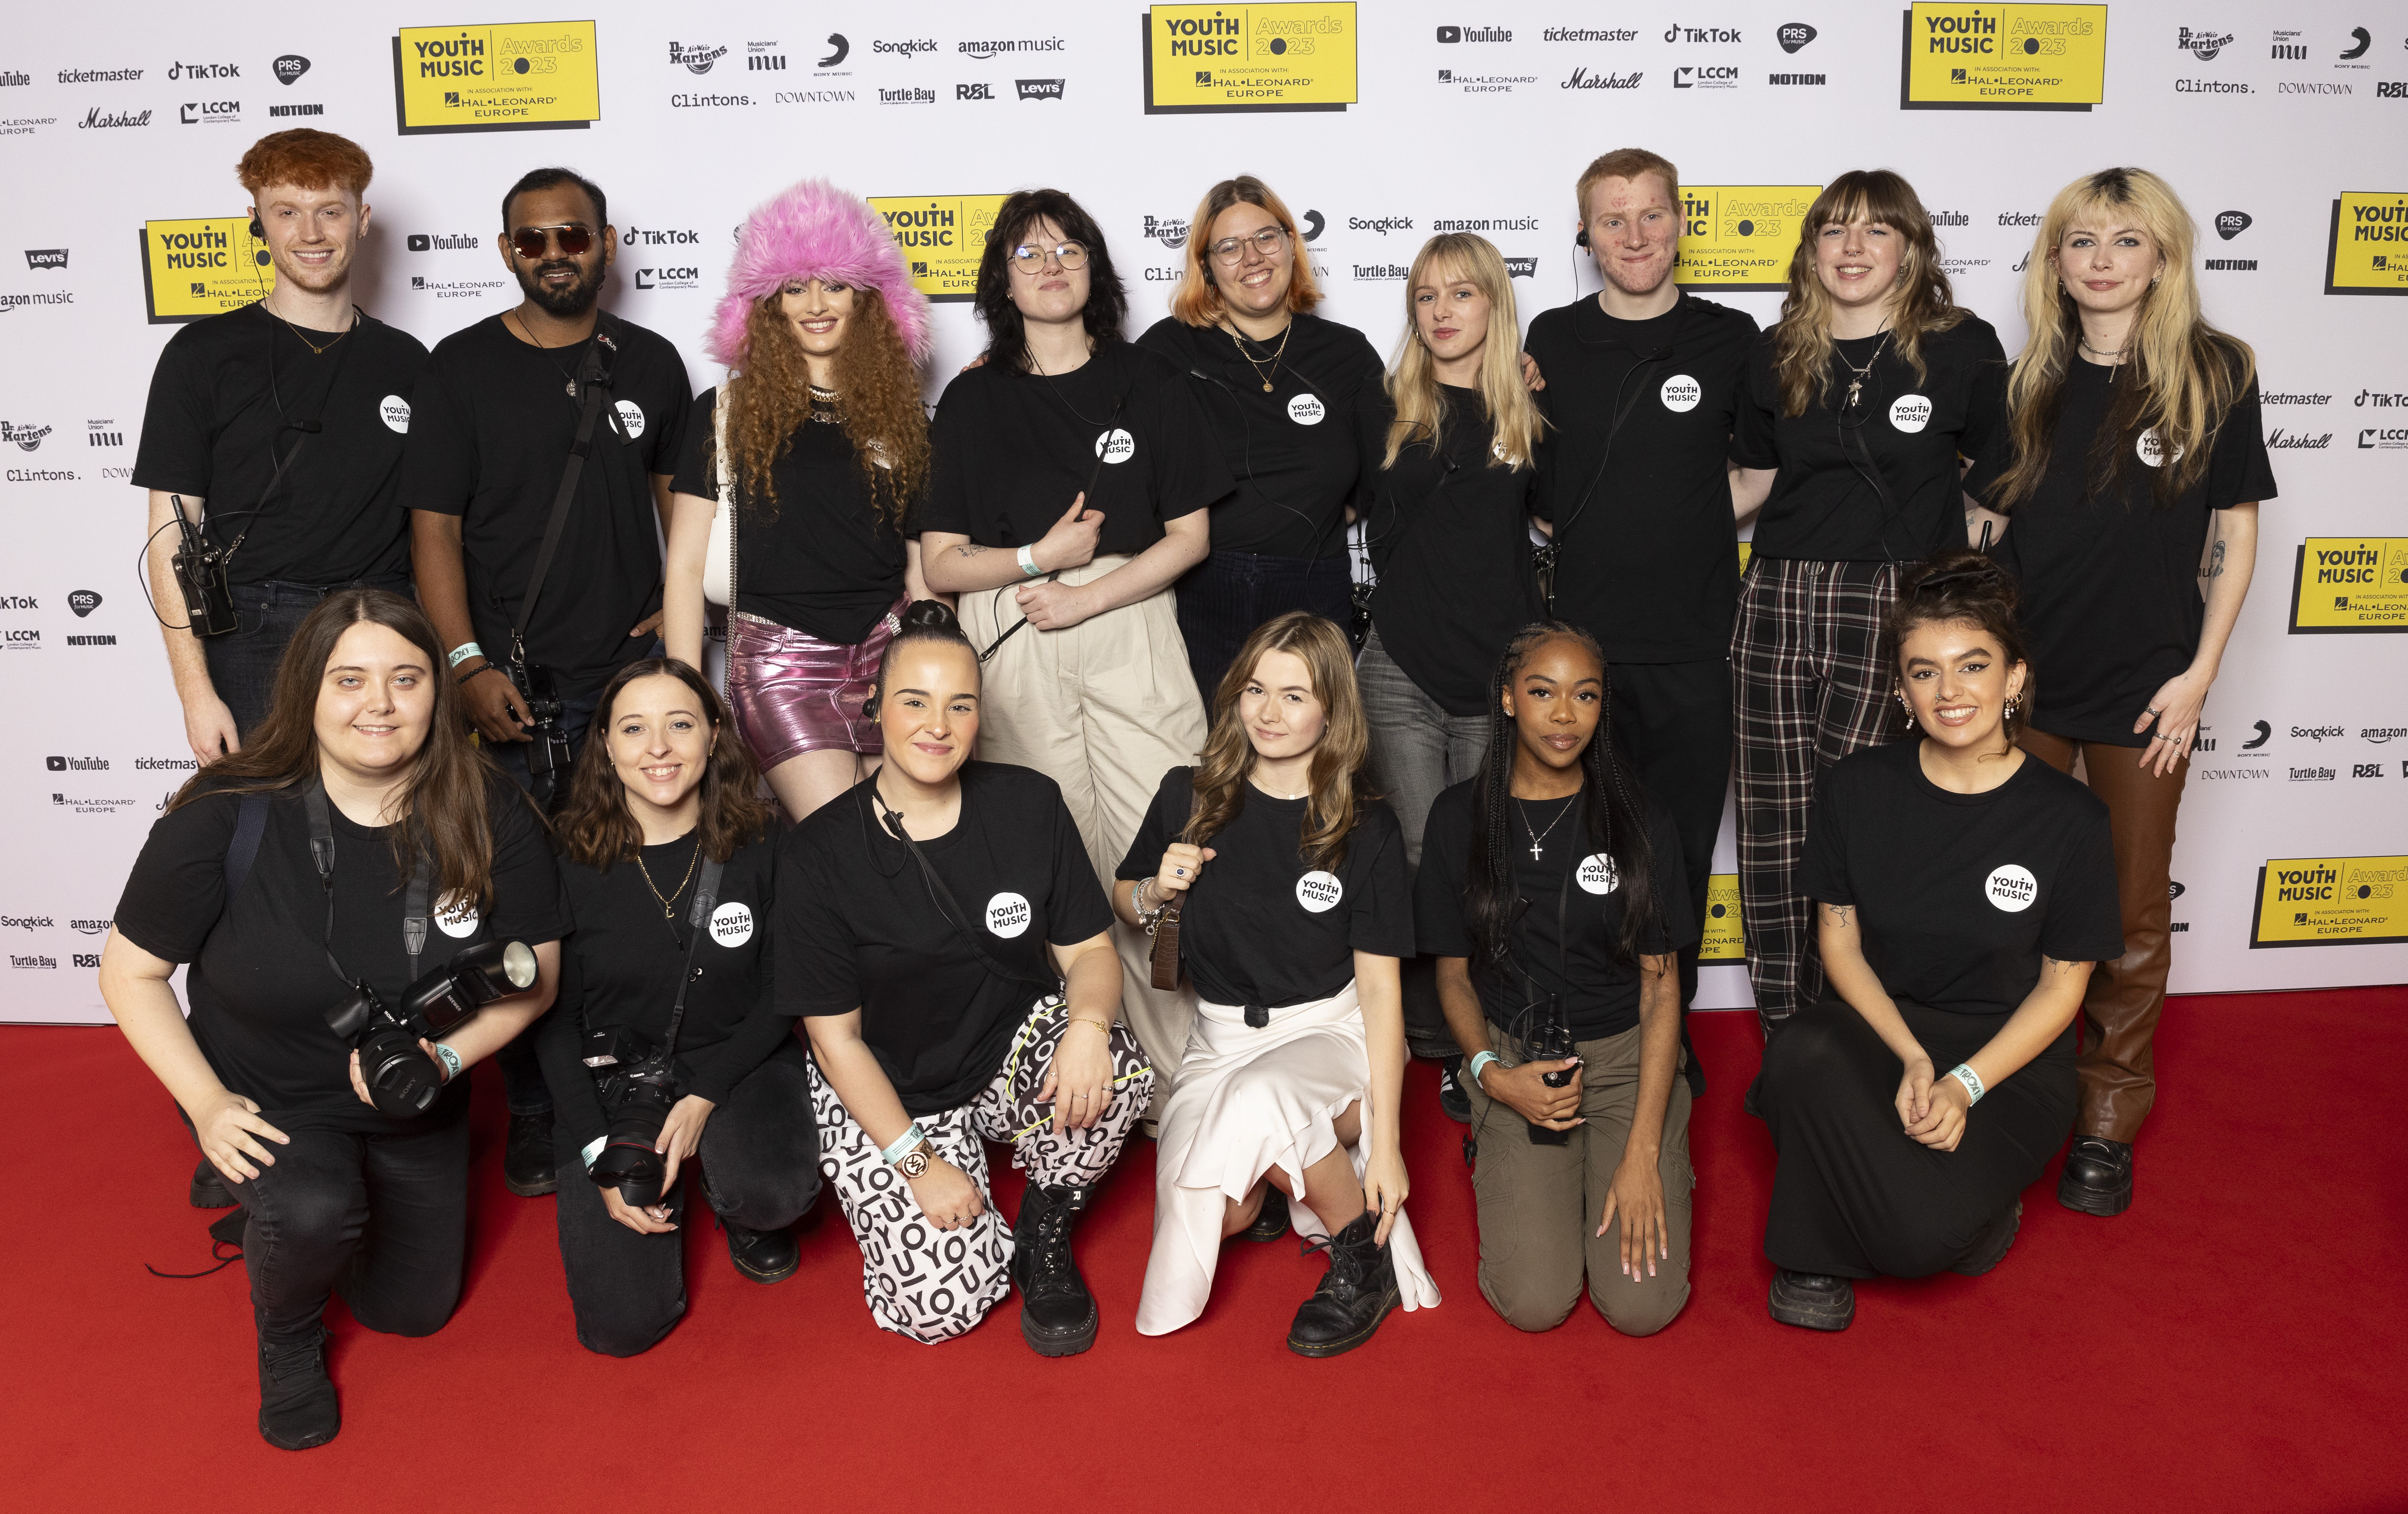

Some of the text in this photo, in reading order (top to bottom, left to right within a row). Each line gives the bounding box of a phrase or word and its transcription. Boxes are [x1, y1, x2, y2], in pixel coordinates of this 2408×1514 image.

[1165, 11, 1239, 36] YOUTH
[1255, 15, 1343, 35] Awards
[1926, 10, 1996, 34] YOUTH
[2010, 17, 2093, 36] Awards
[1463, 26, 1512, 42] YouTube
[1543, 27, 1638, 41] ticketmaster
[1684, 28, 1741, 43] TikTok
[1783, 28, 1807, 39] PRS
[2179, 27, 2193, 38] Dr.
[414, 32, 484, 58] YOUTH
[499, 34, 583, 55] Awards
[669, 41, 685, 53] Dr.
[873, 39, 938, 59] Songkick
[958, 36, 1065, 52] amazon music
[1171, 39, 1238, 56] MUSIC
[1930, 37, 1993, 53] MUSIC
[2178, 33, 2234, 50] Martens
[669, 45, 728, 64] Martens
[185, 63, 240, 79] TikTok
[278, 60, 301, 71] PRS
[421, 59, 484, 78] MUSIC
[1698, 67, 1738, 79] LCCM
[57, 68, 144, 83] ticketmaster
[1561, 67, 1643, 89] Marshall
[1769, 74, 1826, 85] NOTION
[2175, 79, 2255, 94] Clintons.
[2278, 82, 2352, 95] DOWNTOWN
[671, 94, 756, 107] Clintons.
[775, 91, 854, 103] DOWNTOWN
[879, 88, 935, 103] Turtle Bay
[202, 101, 240, 114] LCCM
[269, 104, 323, 117] NOTION
[475, 108, 529, 117] EUROPE
[78, 107, 152, 129] Marshall
[1724, 199, 1808, 218] Awards
[1144, 216, 1159, 226] Dr.
[1349, 216, 1413, 236] Songkick
[1434, 216, 1539, 232] amazon music
[2221, 216, 2242, 226] PRS
[160, 225, 227, 250] YOUTH
[431, 233, 478, 250] YouTube
[642, 230, 700, 245] TikTok
[167, 252, 227, 269] MUSIC
[2205, 259, 2258, 271] NOTION
[659, 267, 698, 279] LCCM
[1352, 264, 1409, 280] Turtle Bay
[33, 290, 73, 304] music
[1666, 384, 1697, 393] YOUTH
[1291, 400, 1320, 411] YOUTH
[1895, 403, 1930, 414] YOUTH
[1294, 410, 1322, 418] MUSIC
[1895, 414, 1927, 423] MUSIC
[0, 421, 14, 431] Dr.
[2, 425, 53, 442] Martens
[7, 469, 81, 482] Clintons.
[2317, 543, 2378, 566] YOUTH
[2318, 568, 2374, 583] MUSIC
[72, 594, 94, 604] PRS
[5, 630, 40, 641] LCCM
[67, 635, 117, 646] NOTION
[2290, 726, 2345, 743] Songkick
[2361, 728, 2407, 739] amazon
[67, 756, 109, 770] YouTube
[2201, 769, 2269, 780] DOWNTOWN
[2289, 767, 2336, 781] Turtle Bay
[2278, 863, 2337, 885] YOUTH
[1303, 879, 1339, 895] YOUTH
[1993, 876, 2034, 892] YOUTH
[1302, 889, 1336, 904] MUSIC
[1992, 886, 2030, 901] MUSIC
[2278, 886, 2333, 901] MUSIC
[989, 901, 1027, 918] YOUTH
[1, 916, 54, 932] Songkick
[713, 912, 750, 927] YOUTH
[993, 914, 1028, 928] MUSIC
[717, 924, 751, 937] MUSIC
[10, 955, 57, 969] Turtle Bay
[447, 994, 462, 1012] NEEWER
[384, 1010, 395, 1023] SONY
[1960, 1068, 1981, 1096] TROXY
